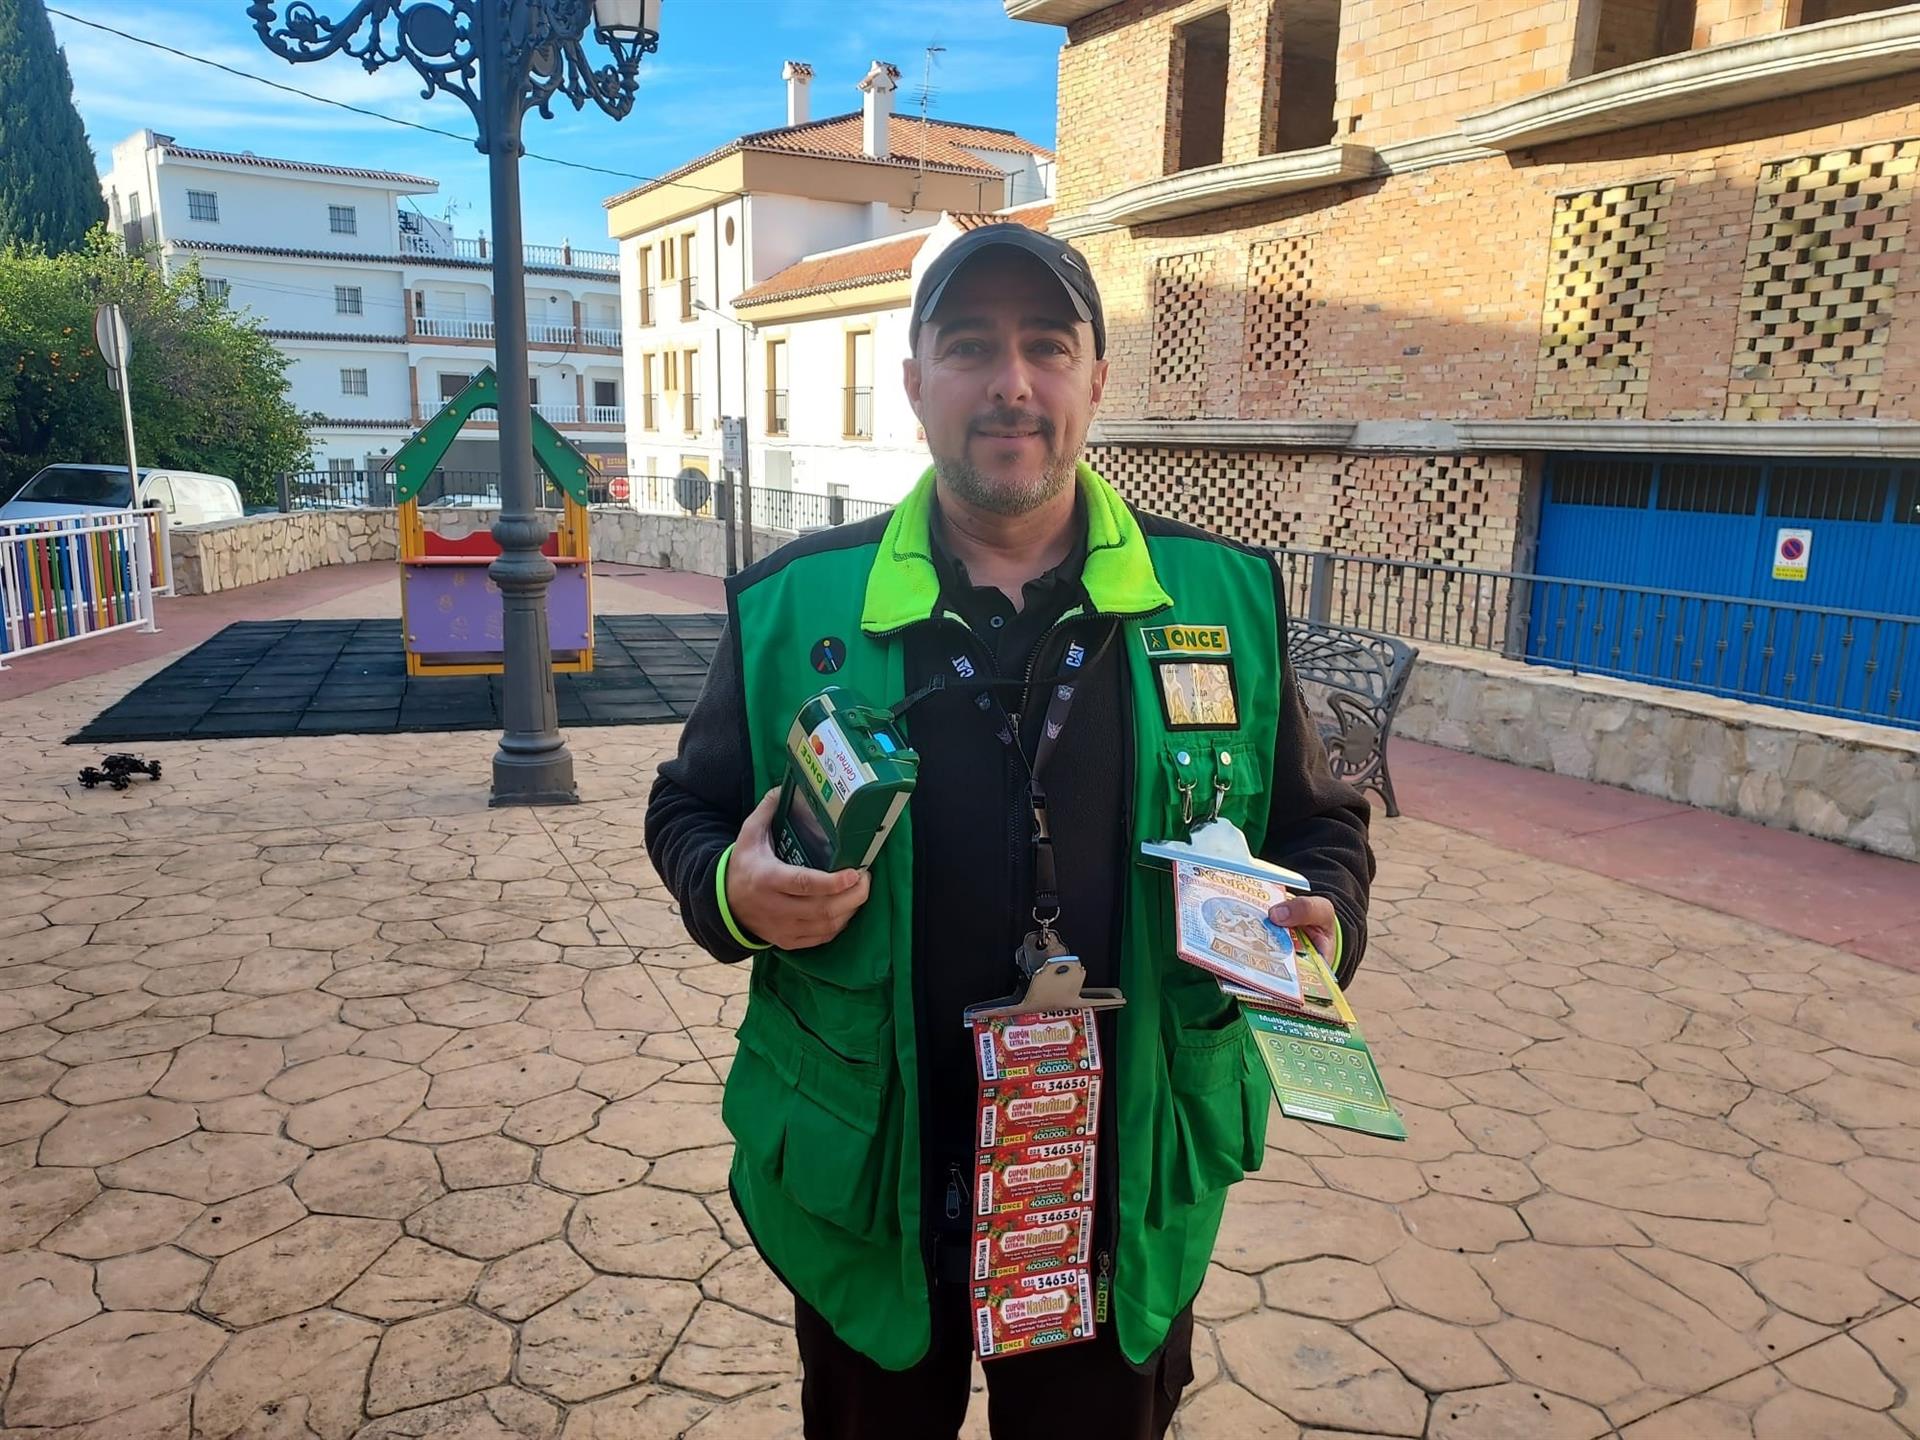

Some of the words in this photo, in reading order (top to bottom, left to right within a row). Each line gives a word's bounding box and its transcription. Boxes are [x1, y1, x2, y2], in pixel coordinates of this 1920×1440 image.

[1171, 630, 1222, 648] ONCE
[1066, 640, 1084, 668] CAT
[952, 656, 974, 678] CAT
[800, 746, 822, 784] ONCE
[836, 752, 856, 782] Getnet
[837, 780, 847, 796] VISA
[1258, 1014, 1304, 1028] Multiplica
[1008, 1029, 1029, 1040] CUPÓN
[1030, 1026, 1070, 1044] Navidad
[1272, 1025, 1287, 1033] x2,
[1290, 1028, 1302, 1036] x5,
[1330, 1036, 1345, 1044] x20
[1036, 1064, 1073, 1074] 400.000€
[1048, 1077, 1086, 1092] 34656
[1012, 1100, 1032, 1112] CUPÓN
[1033, 1097, 1072, 1114] Navidad
[1044, 1144, 1081, 1157] 34656
[1008, 1167, 1028, 1178] CUPÓN
[1030, 1163, 1068, 1180] Navidad
[1041, 1209, 1078, 1223] 34656
[1005, 1233, 1025, 1243] CUPÓN
[1026, 1227, 1064, 1244] Navidad
[1038, 1274, 1075, 1288] 34656
[1006, 1301, 1025, 1312] CUPÓN
[1026, 1295, 1064, 1314] Navidad
[1097, 1293, 1106, 1321] ONCE
[1004, 1340, 1022, 1350] ONCE
